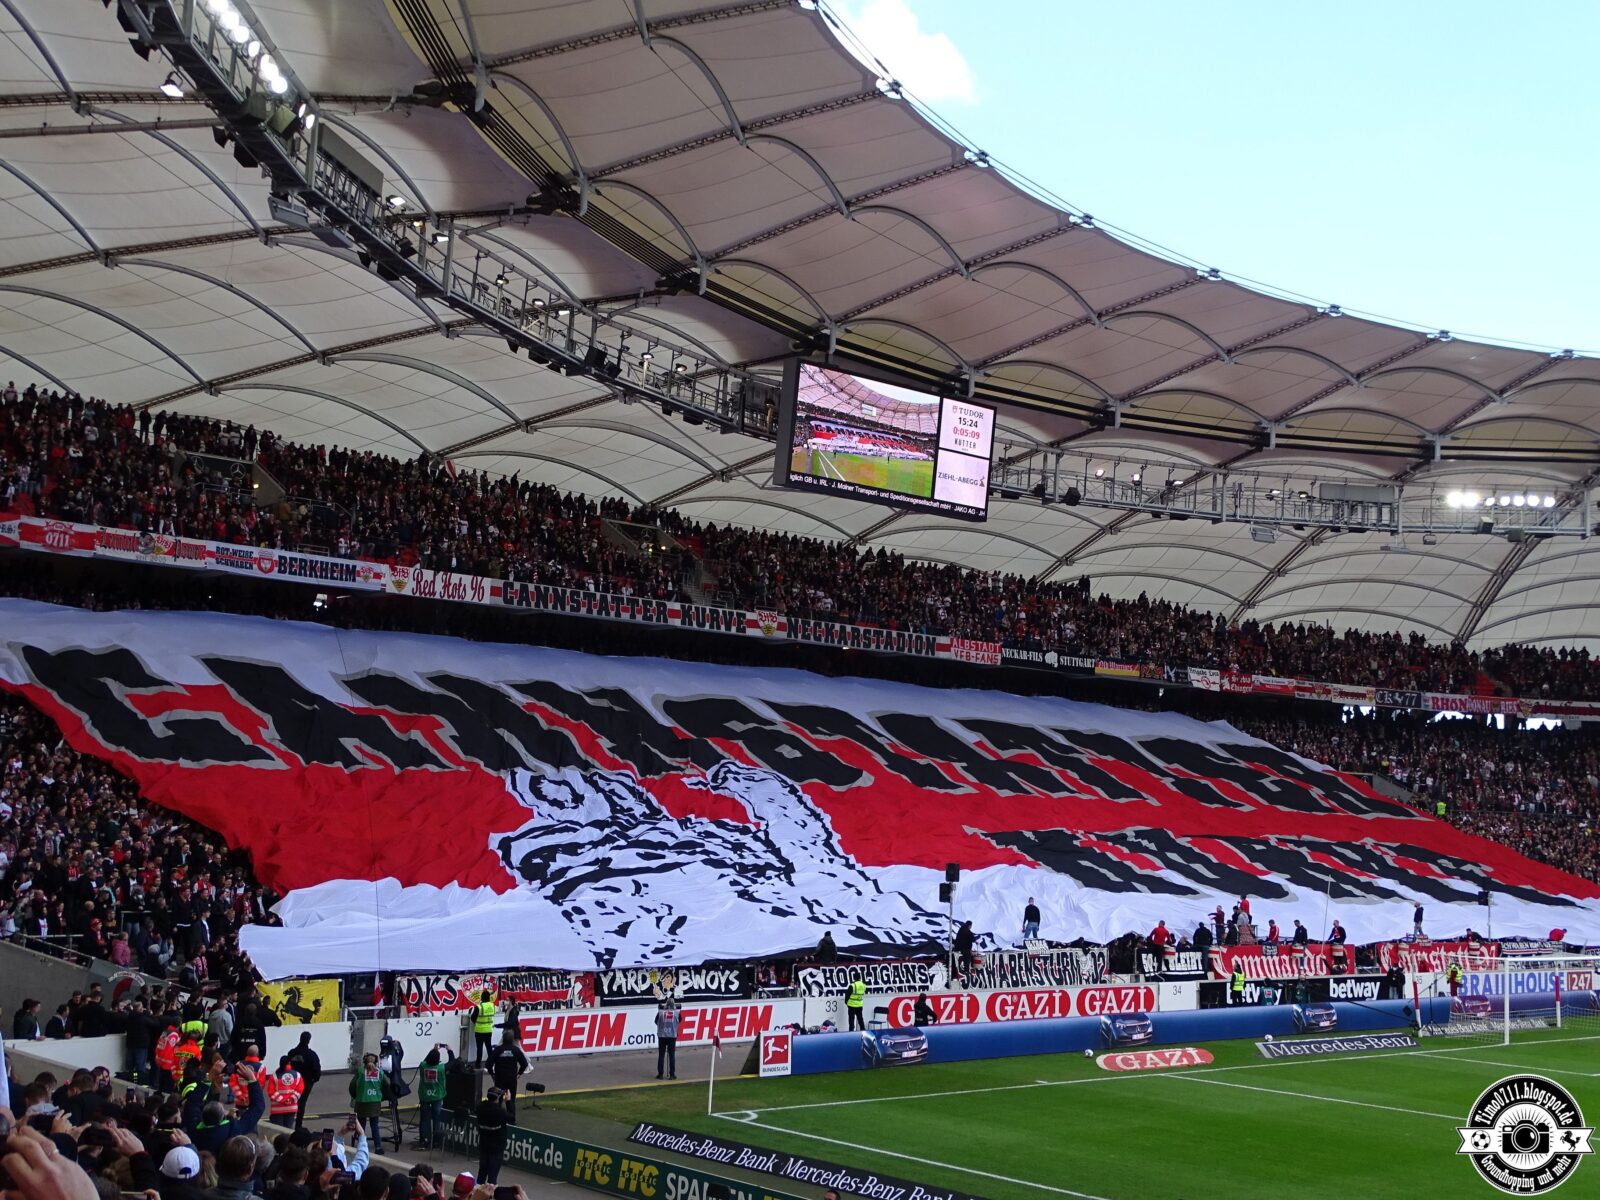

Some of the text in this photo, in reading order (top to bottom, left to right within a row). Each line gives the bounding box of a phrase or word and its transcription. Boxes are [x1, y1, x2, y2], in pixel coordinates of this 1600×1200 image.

[959, 407, 984, 419] TUDOR
[958, 417, 978, 428] 15:24
[953, 427, 980, 440] 0:05:09
[937, 471, 979, 486] ZIEHL-ABEGG
[45, 531, 70, 548] 0711
[215, 557, 254, 571] SCHWABEN
[277, 554, 357, 583] BERKHEIM
[411, 568, 485, 602] Red Hots 96
[502, 580, 747, 634] CANNSTATTER KURVE
[786, 616, 937, 657] NECKARSTADION
[952, 638, 1000, 654] ALBSTADT
[953, 649, 999, 665] VFB-FANS
[1001, 647, 1096, 669] NECKAR-FILS STUTTGART
[1404, 692, 1418, 706] 77
[500, 972, 572, 992] SUPPORTERS
[600, 967, 740, 995] YARD BWOYS
[821, 962, 929, 989] HOOLIGANS
[1572, 973, 1591, 991] 247
[404, 975, 460, 1007] DKS
[1172, 984, 1182, 996] 34
[1329, 978, 1381, 1001] betway
[825, 1000, 838, 1014] 33
[414, 1022, 433, 1038] 32
[1268, 1033, 1417, 1058] Mercedes-Benz
[762, 1065, 789, 1074] BUNDESLIGA
[366, 1088, 377, 1097] 06
[631, 1123, 735, 1163] Mercedes-Benz
[735, 1147, 778, 1173] Bank
[779, 1157, 905, 1200] Mercedes-Benz
[572, 1147, 614, 1186] ITC
[617, 1158, 660, 1198] ITC
